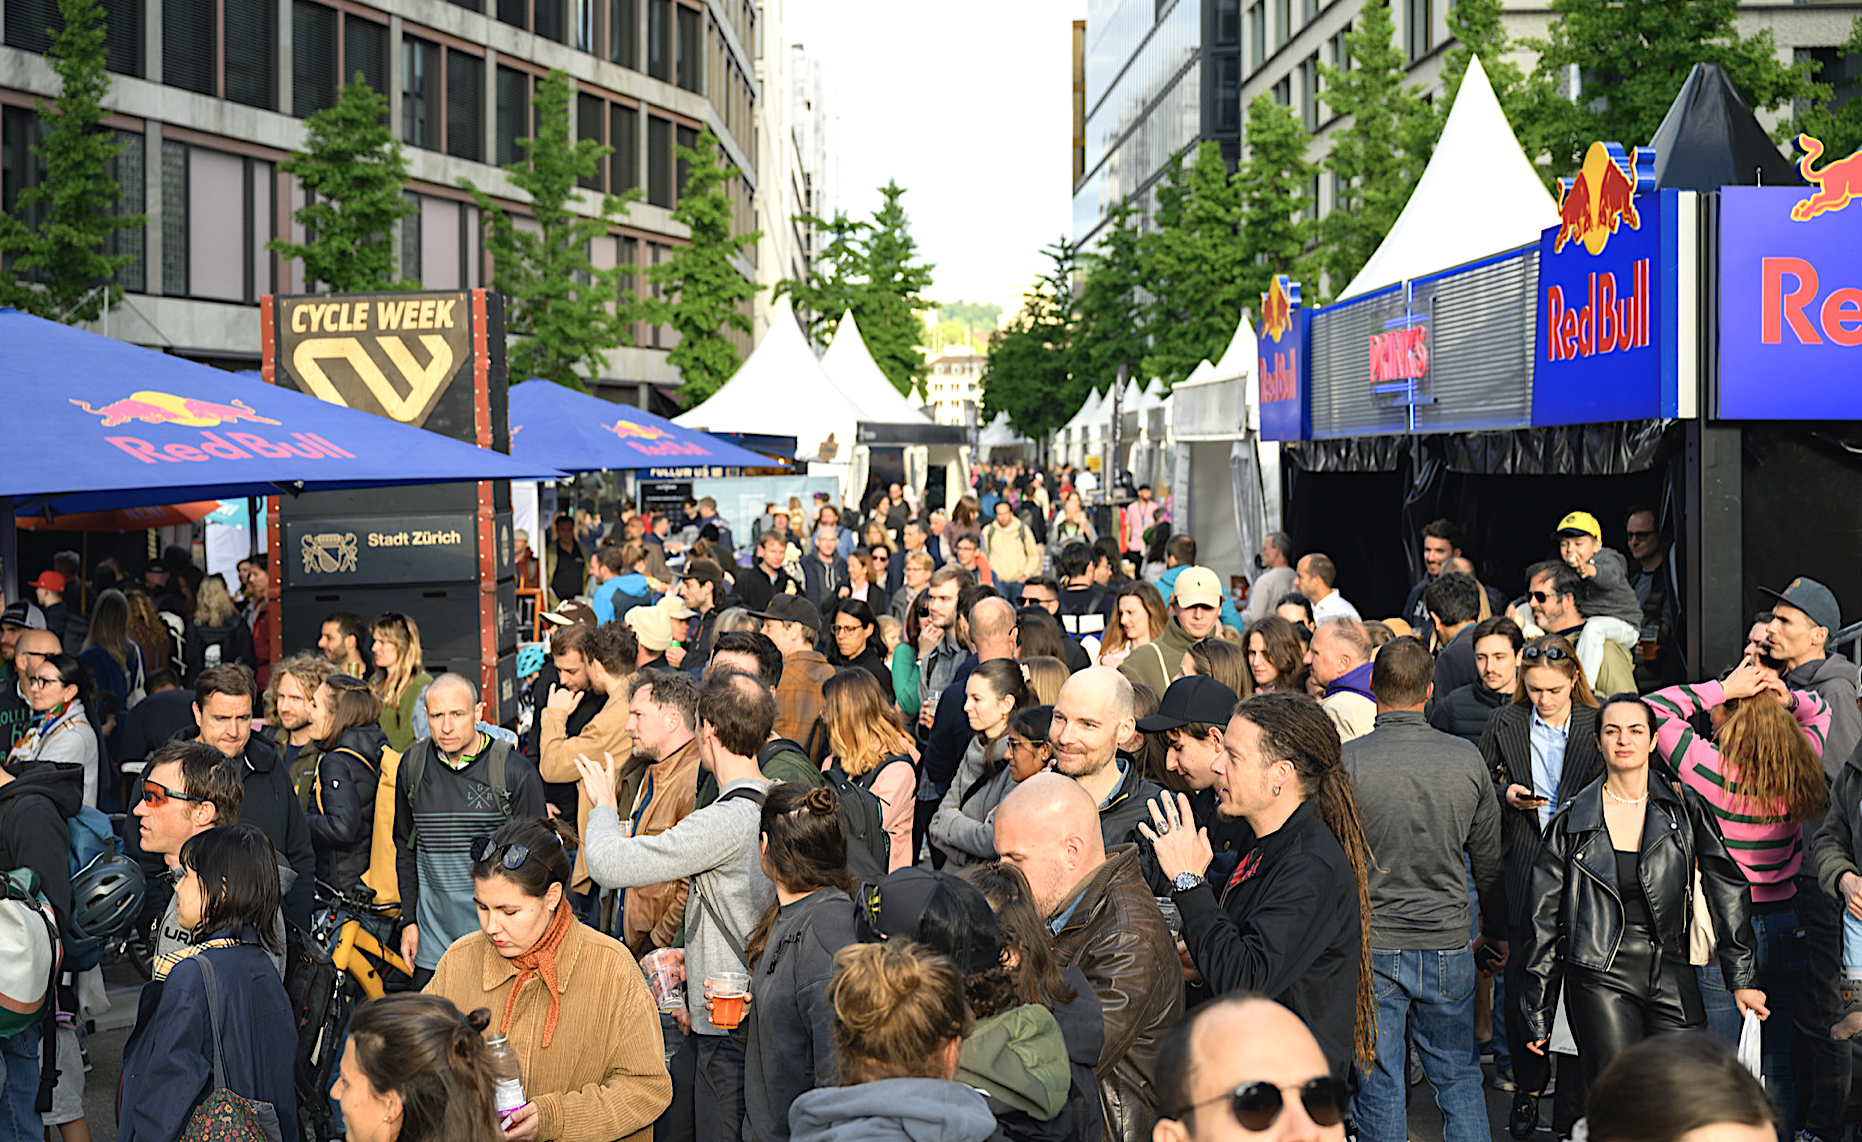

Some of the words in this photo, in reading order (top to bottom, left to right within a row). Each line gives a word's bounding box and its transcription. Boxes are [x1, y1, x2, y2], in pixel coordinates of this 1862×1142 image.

[291, 302, 370, 333] CYCLE
[376, 299, 456, 331] WEEK
[1761, 257, 1862, 346] Re
[1368, 324, 1427, 383] DRINKS
[367, 531, 410, 548] Stadt
[411, 529, 461, 546] Zürich
